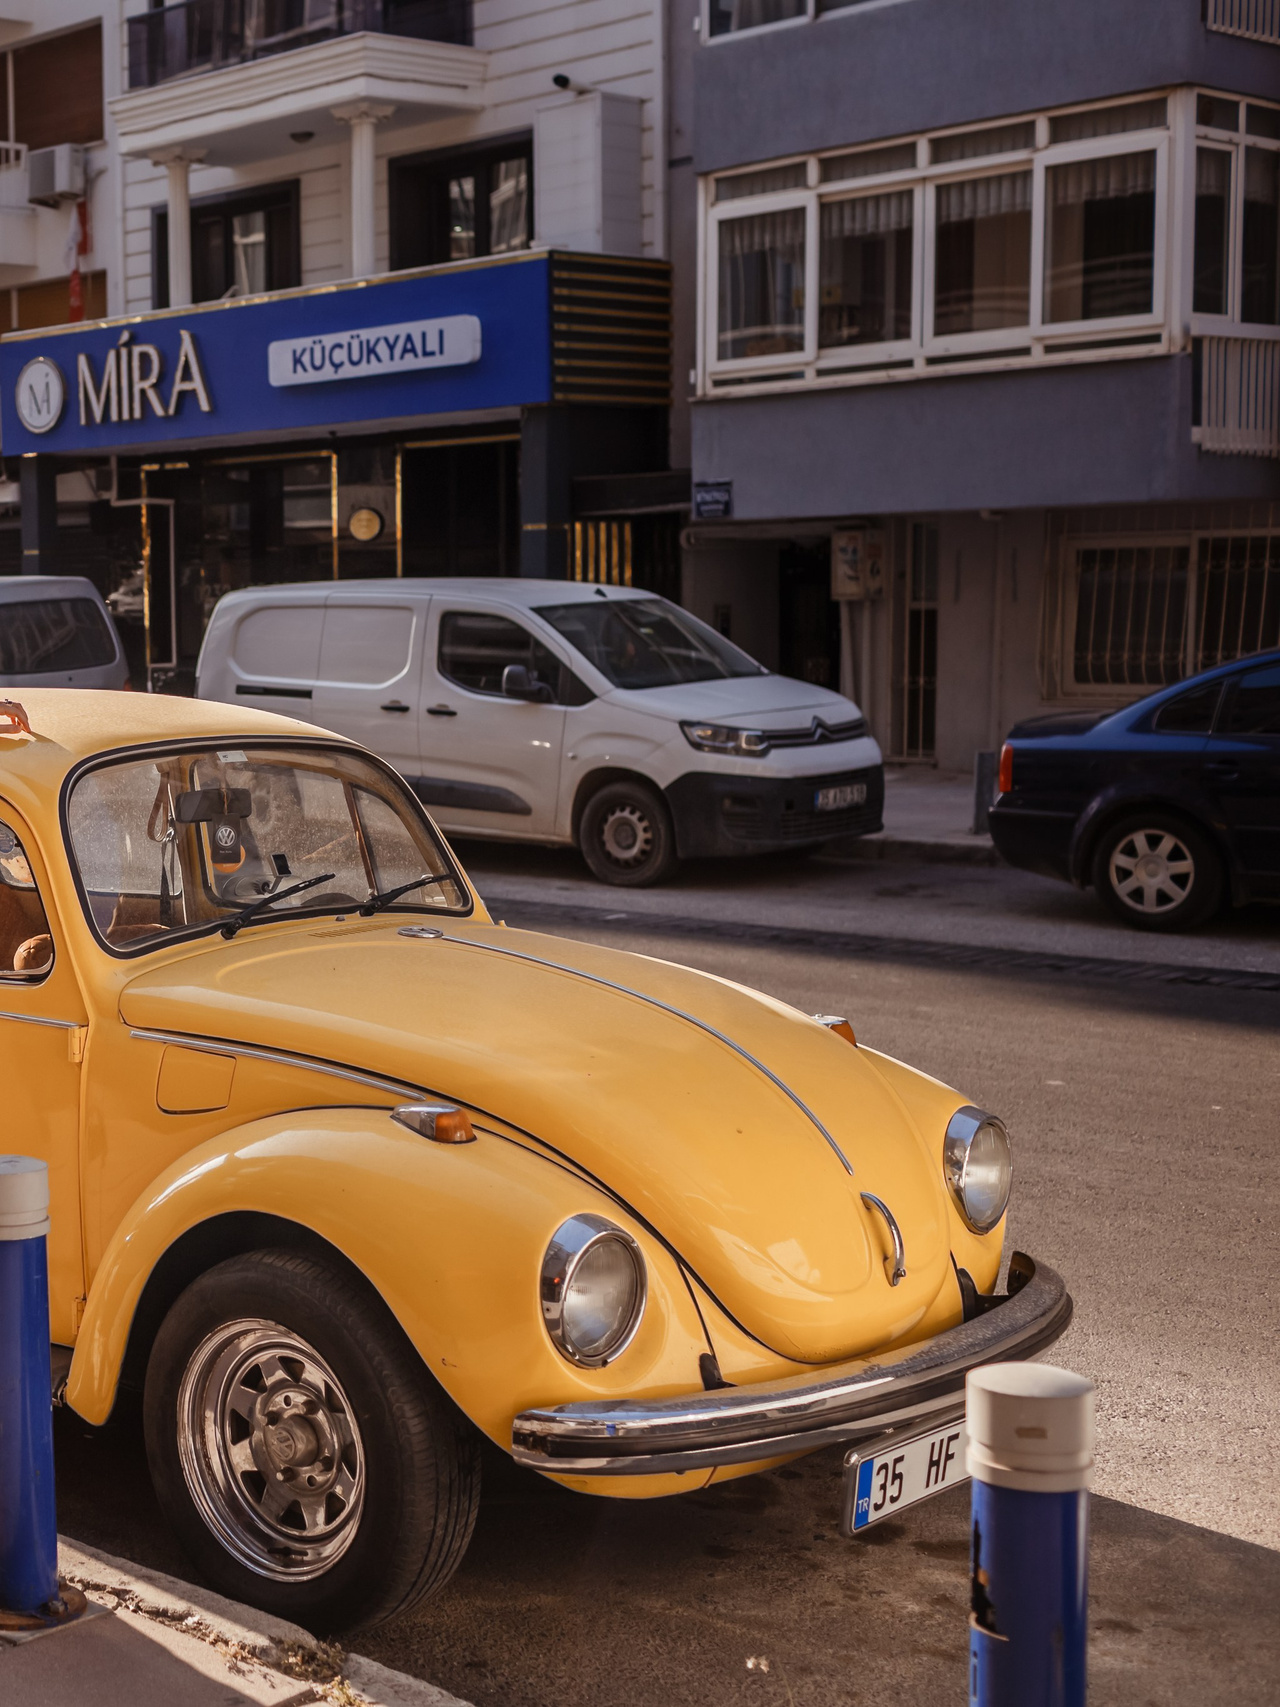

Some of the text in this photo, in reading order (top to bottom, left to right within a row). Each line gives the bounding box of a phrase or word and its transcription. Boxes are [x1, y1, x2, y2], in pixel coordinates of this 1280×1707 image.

[292, 328, 445, 375] KÜÇÜKYALI
[873, 1432, 960, 1512] 35 HF
[858, 1498, 869, 1513] TR
